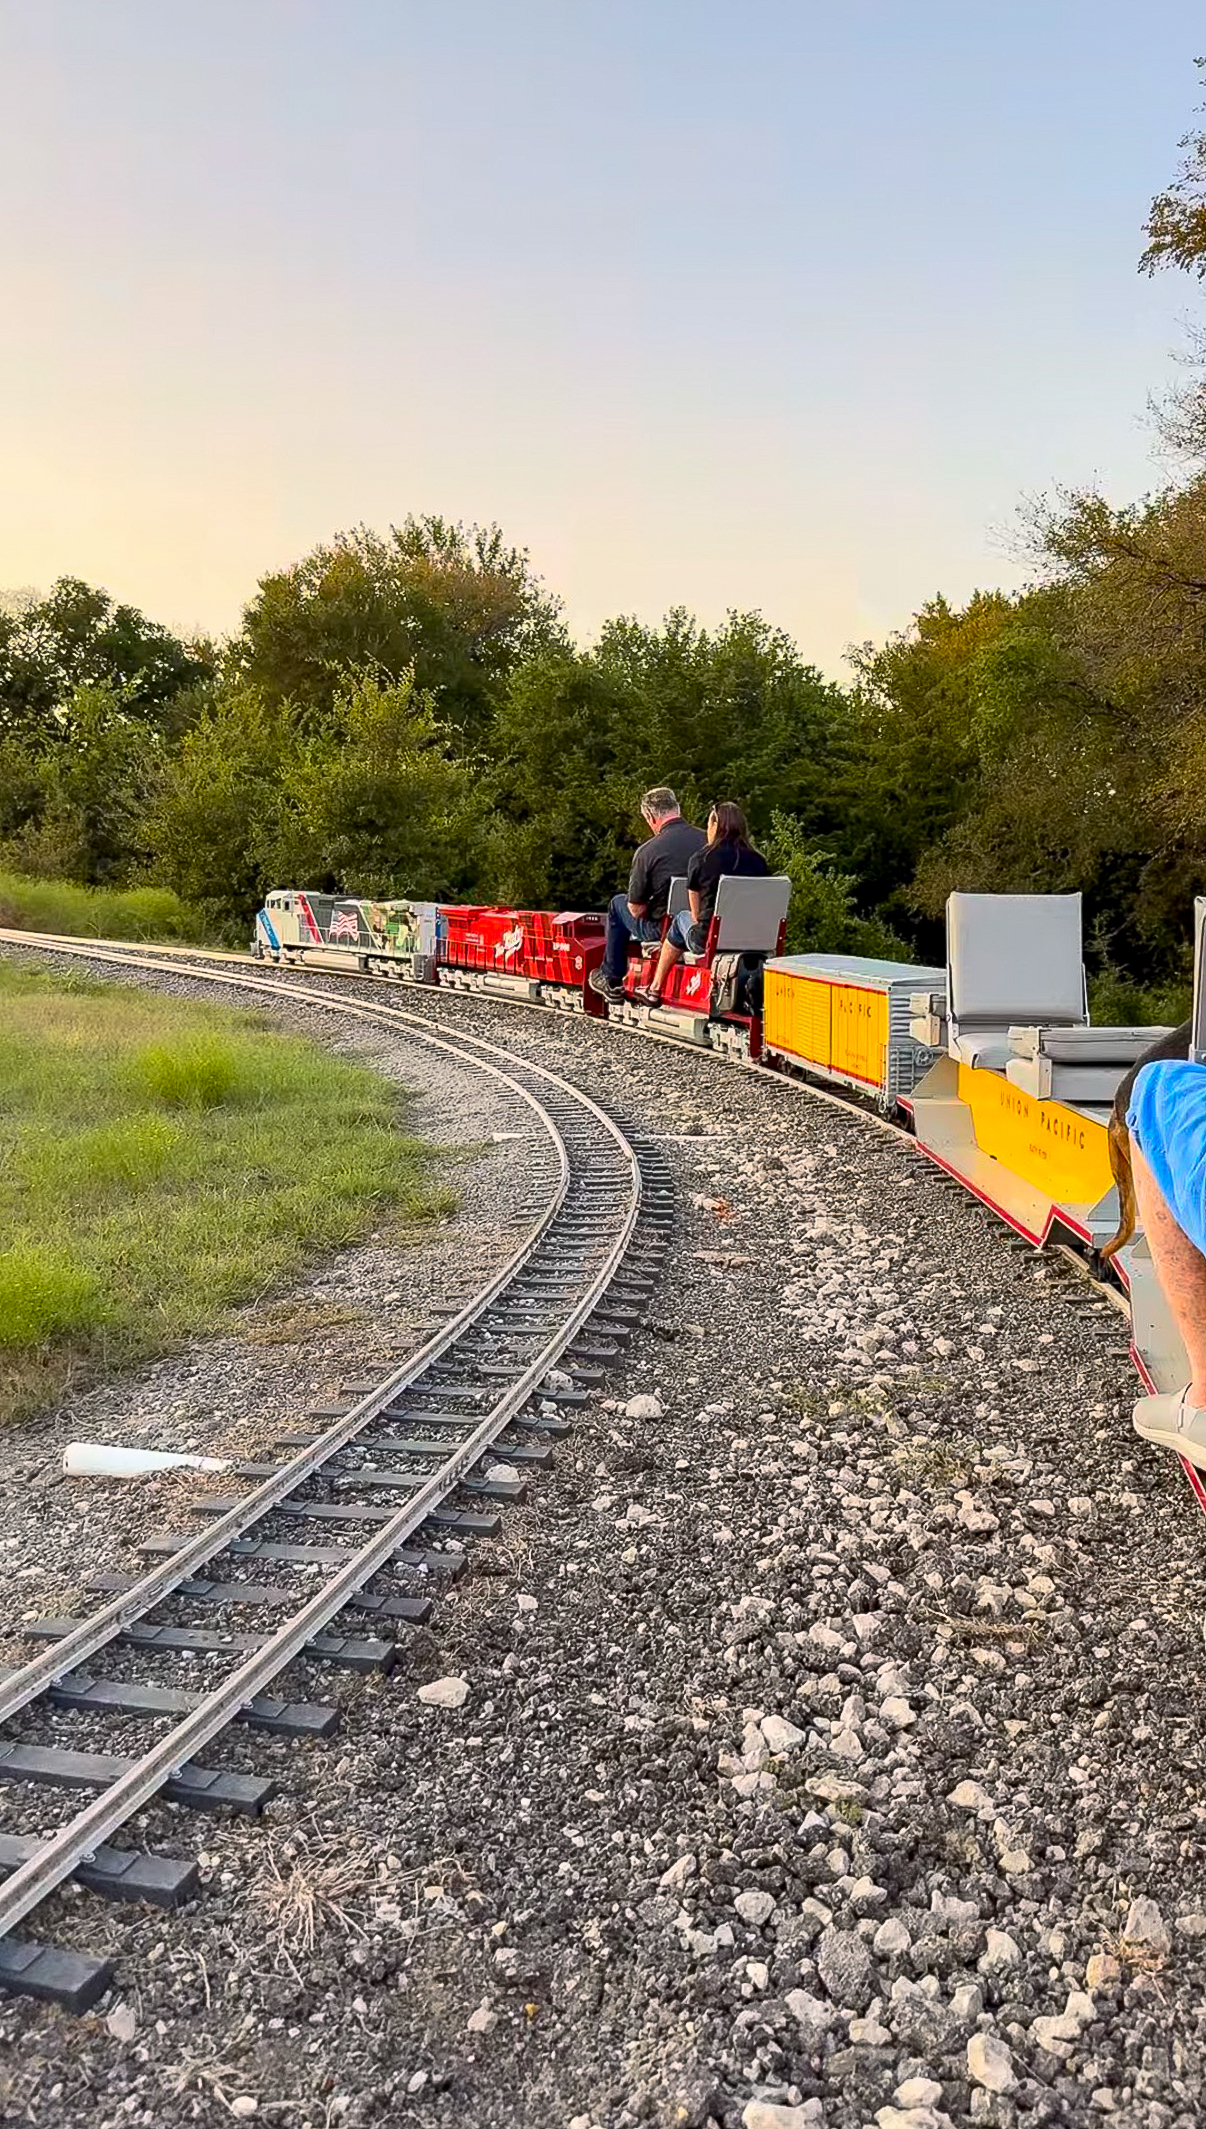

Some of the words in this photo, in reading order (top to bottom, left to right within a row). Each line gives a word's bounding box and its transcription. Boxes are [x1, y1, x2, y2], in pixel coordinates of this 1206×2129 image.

[839, 998, 872, 1018] PACFIC
[1000, 1090, 1029, 1118] UNION
[1040, 1111, 1085, 1150] PACIFIC
